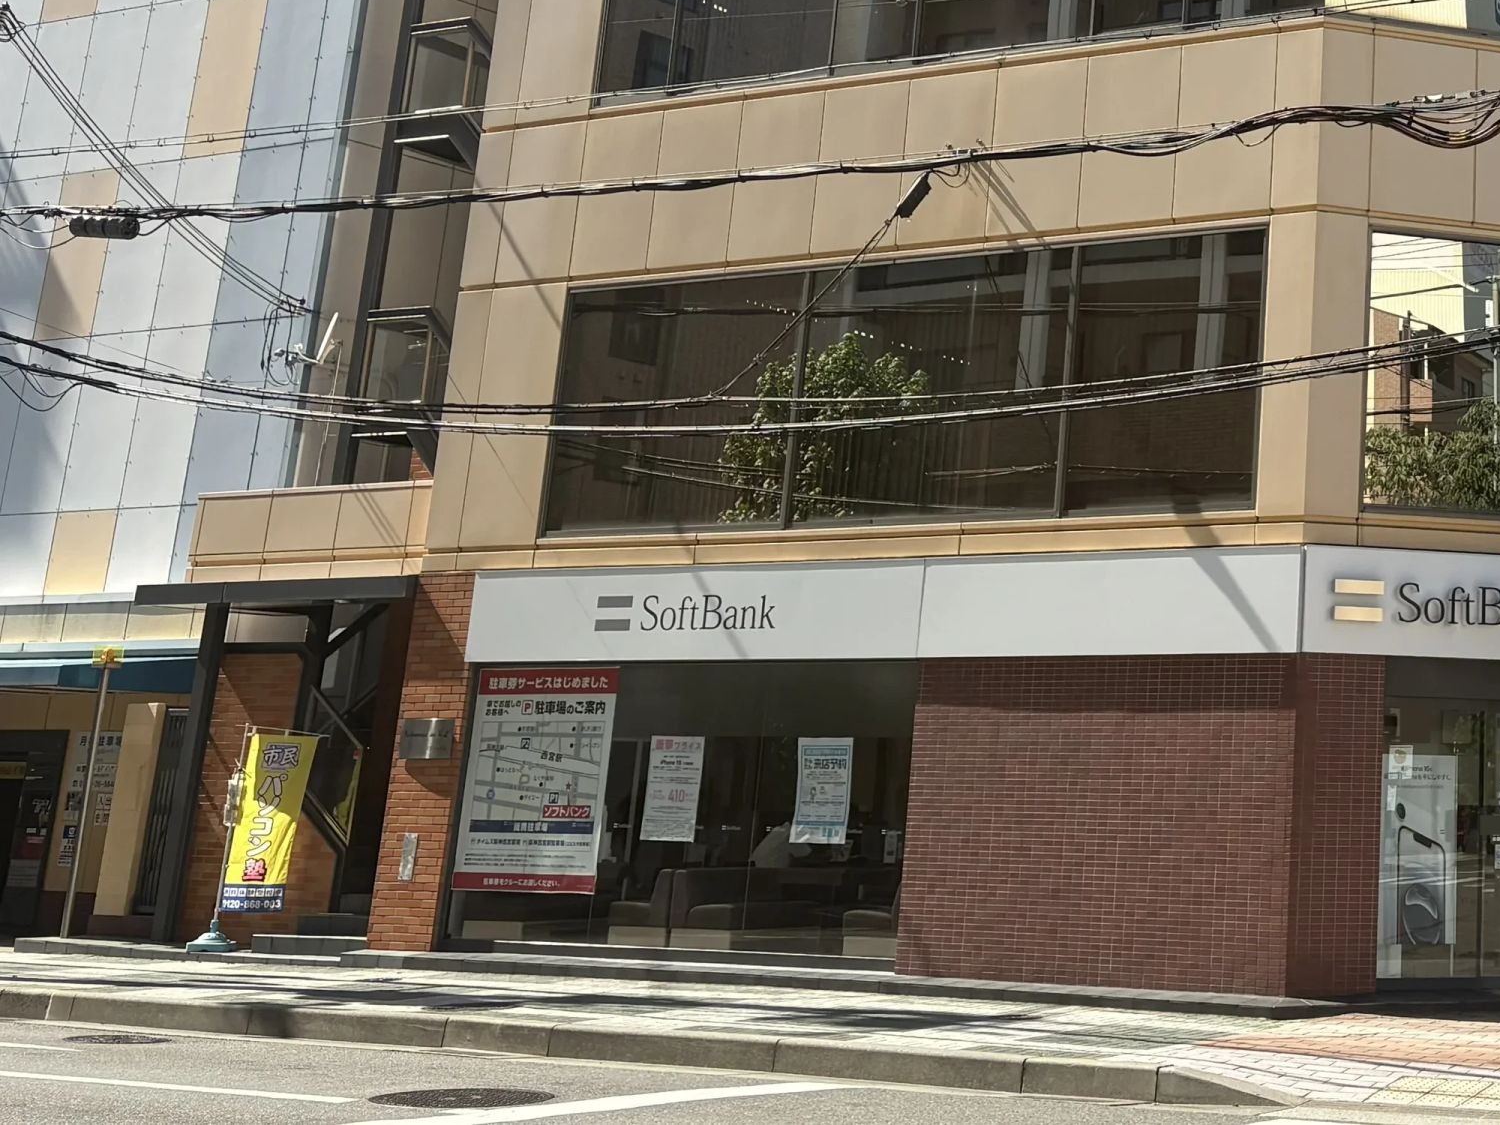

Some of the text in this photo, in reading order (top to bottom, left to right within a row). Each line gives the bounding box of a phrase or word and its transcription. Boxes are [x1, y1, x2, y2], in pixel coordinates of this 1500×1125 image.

[639, 593, 776, 632] SoftBank
[488, 676, 609, 690] 駐車券サービスはじめました
[535, 701, 606, 715] 駐車場のご案内
[263, 745, 300, 767] 市民
[544, 806, 591, 818] ソフトバンク
